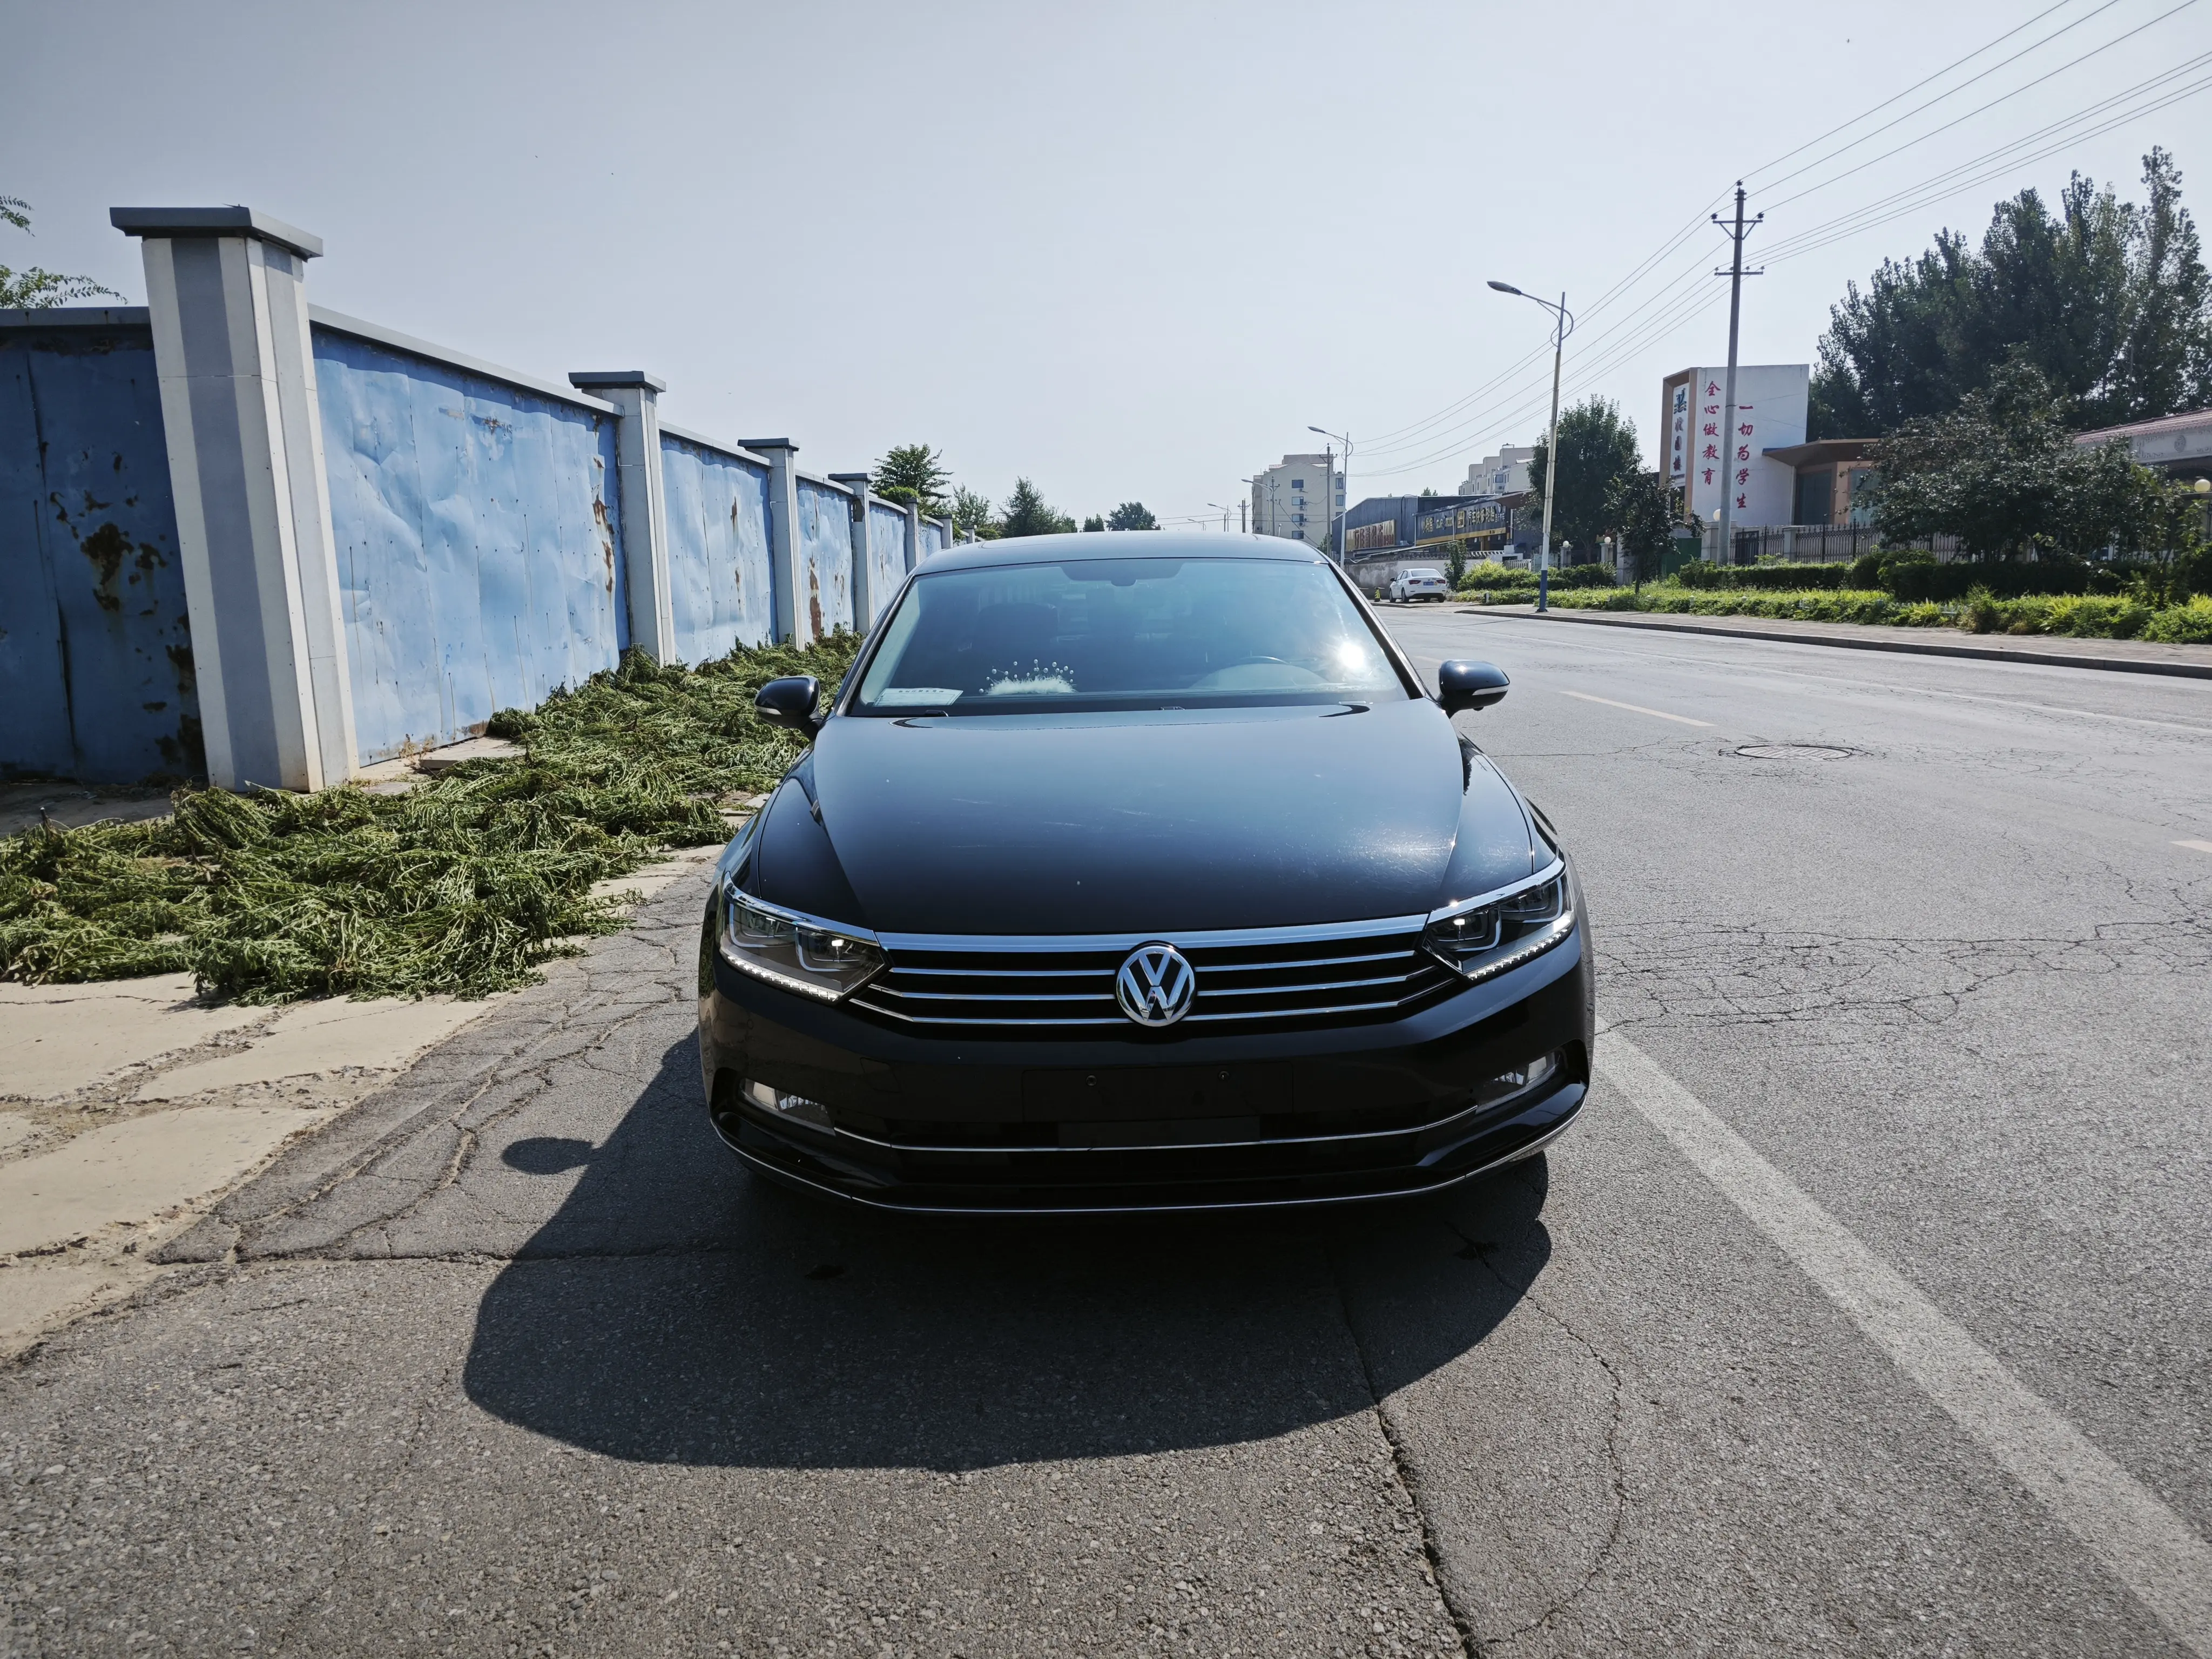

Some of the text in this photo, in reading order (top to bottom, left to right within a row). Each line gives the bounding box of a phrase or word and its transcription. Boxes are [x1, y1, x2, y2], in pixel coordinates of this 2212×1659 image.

[1702, 381, 1721, 485] 全心做教育
[1736, 406, 1754, 508] 一切为学生
